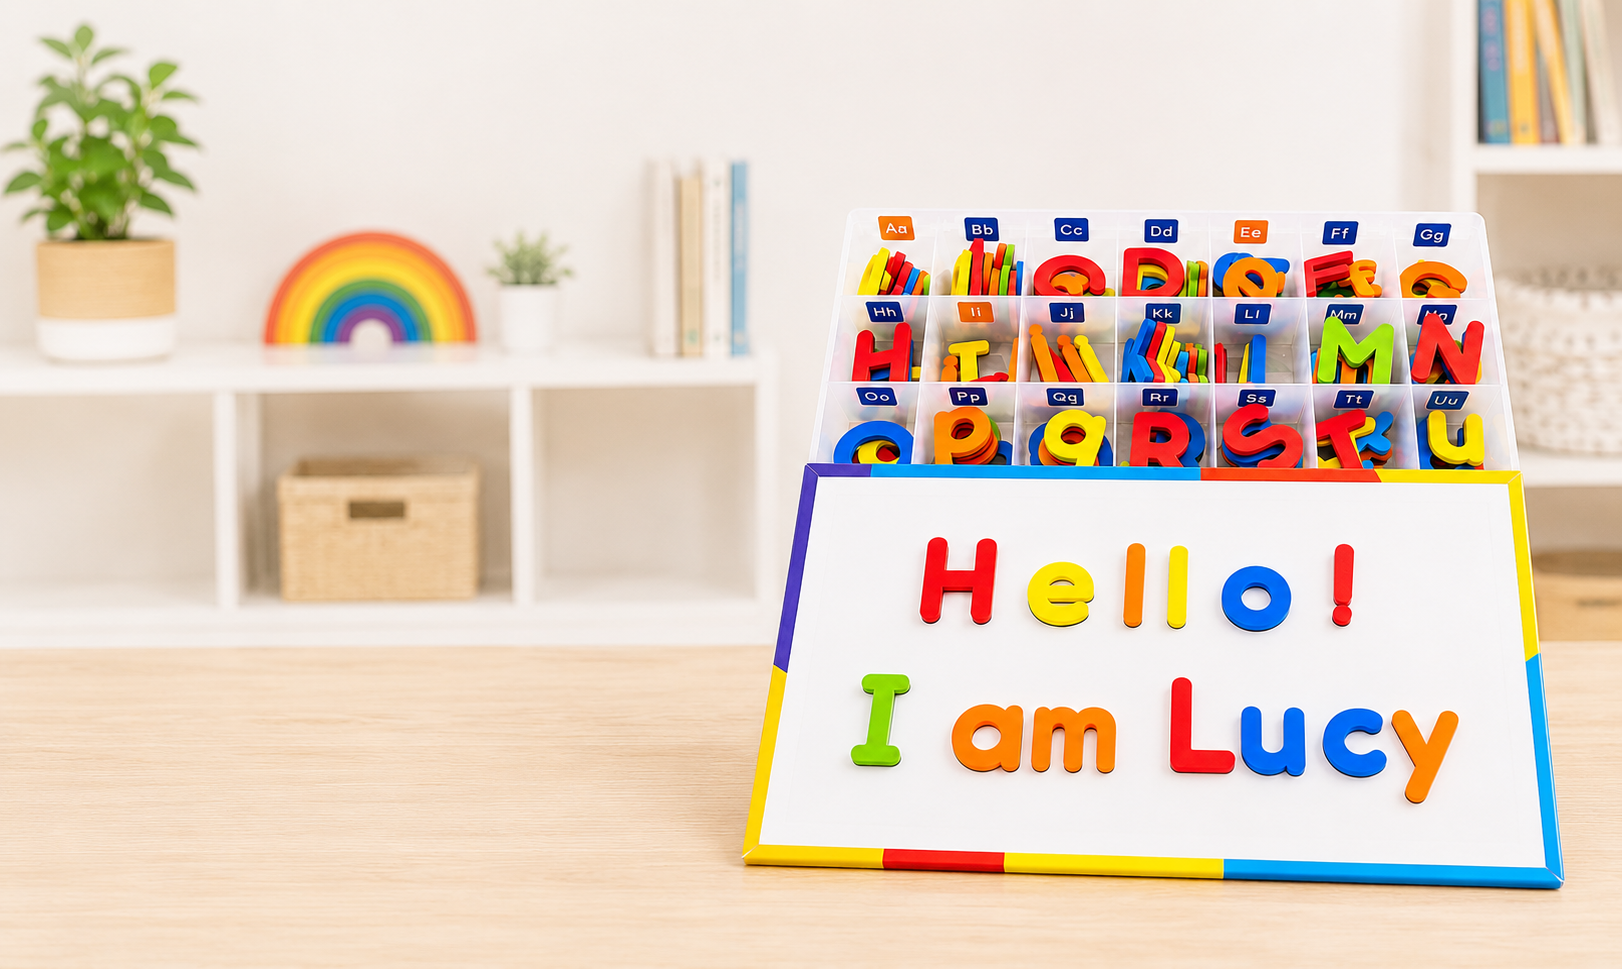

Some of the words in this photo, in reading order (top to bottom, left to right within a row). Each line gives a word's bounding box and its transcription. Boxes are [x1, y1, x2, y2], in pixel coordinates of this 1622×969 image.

[886, 223, 907, 234] Aa
[972, 225, 993, 236] Bb
[1061, 225, 1083, 236] Cc
[1150, 226, 1172, 237] Dd
[1240, 227, 1261, 238] Ee
[1331, 228, 1349, 239] Ff
[1420, 229, 1444, 243] Gg
[874, 307, 896, 317] Hh
[1060, 308, 1075, 319] Jj
[1153, 309, 1173, 319] Kk
[865, 392, 889, 401] Oo
[957, 392, 980, 403] Pp
[1150, 393, 1169, 402] Rr
[1246, 394, 1267, 404] Ss
[1346, 395, 1363, 404] Tt
[1434, 395, 1458, 405] Uu
[851, 674, 910, 768] I
[951, 704, 1117, 774] am
[1170, 677, 1459, 804] Lucy
